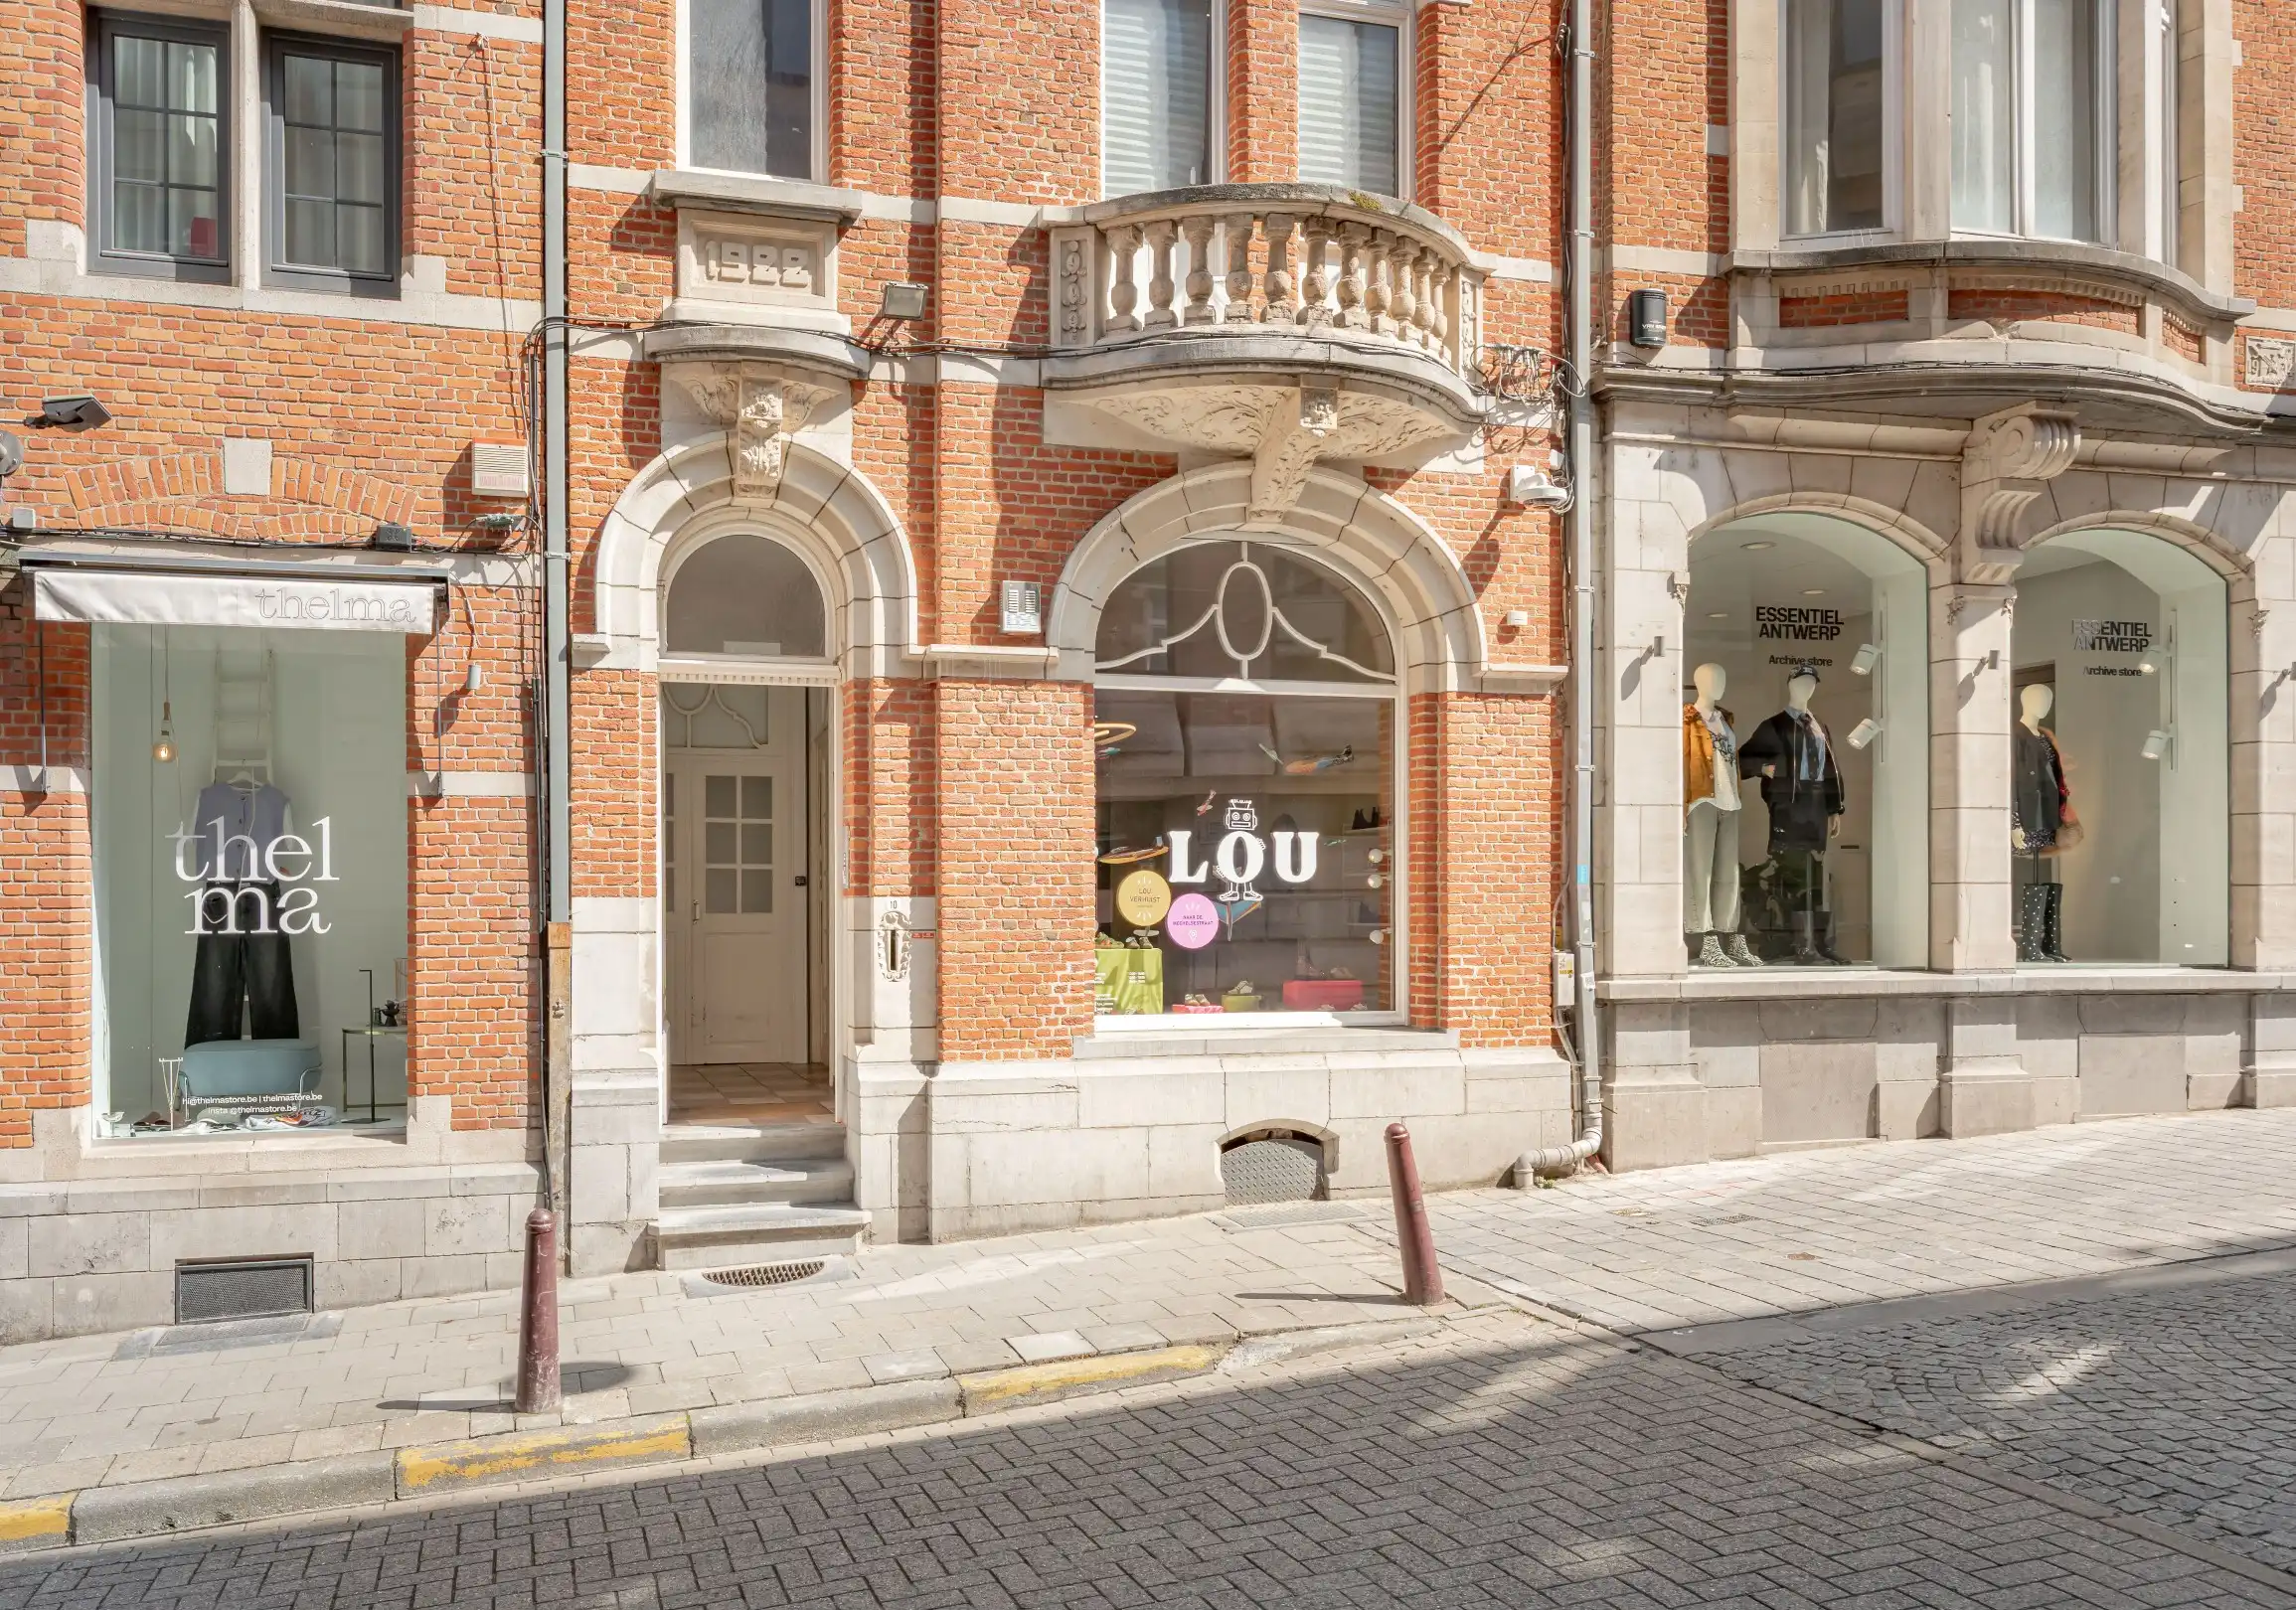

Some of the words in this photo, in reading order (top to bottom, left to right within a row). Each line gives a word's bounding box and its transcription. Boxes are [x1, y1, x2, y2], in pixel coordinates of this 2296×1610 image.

[255, 587, 416, 623] thelma
[1755, 605, 1845, 625] ESSENTIEL
[1758, 622, 1841, 641] ANTWERP
[2071, 618, 2153, 638] ESSENTIEL
[2073, 635, 2150, 653] ANTWERP
[1768, 654, 1806, 666] Archive
[1808, 656, 1833, 667] store
[2083, 665, 2117, 677] Archive
[2118, 667, 2142, 677] store
[165, 815, 340, 882] thel
[1167, 830, 1320, 885] LOU
[184, 886, 332, 935] ma
[890, 899, 898, 909] 10
[182, 1095, 257, 1105] hi@thelmastore.be
[262, 1092, 323, 1103] thelmastore.be
[230, 1104, 297, 1115] @thelmastore.be
